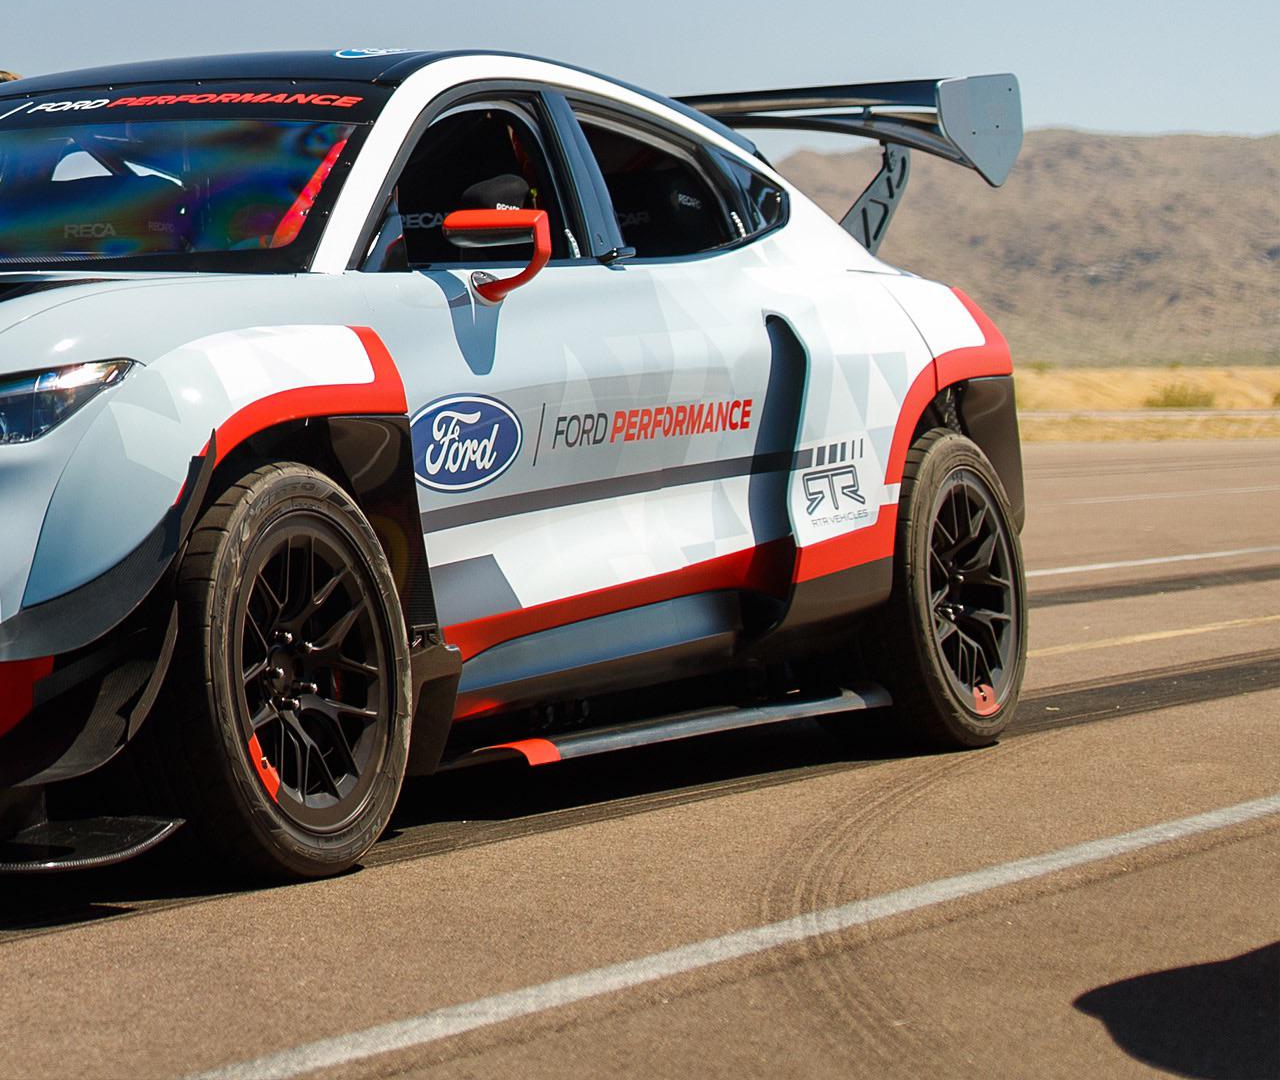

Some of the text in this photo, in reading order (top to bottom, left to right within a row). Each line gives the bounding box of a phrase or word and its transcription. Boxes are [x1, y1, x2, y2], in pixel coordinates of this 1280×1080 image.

[27, 99, 110, 114] FORD
[107, 93, 365, 108] PERFORMANCE
[425, 399, 753, 475] Ford FORD PERFORMANCE
[801, 464, 866, 516] RTR
